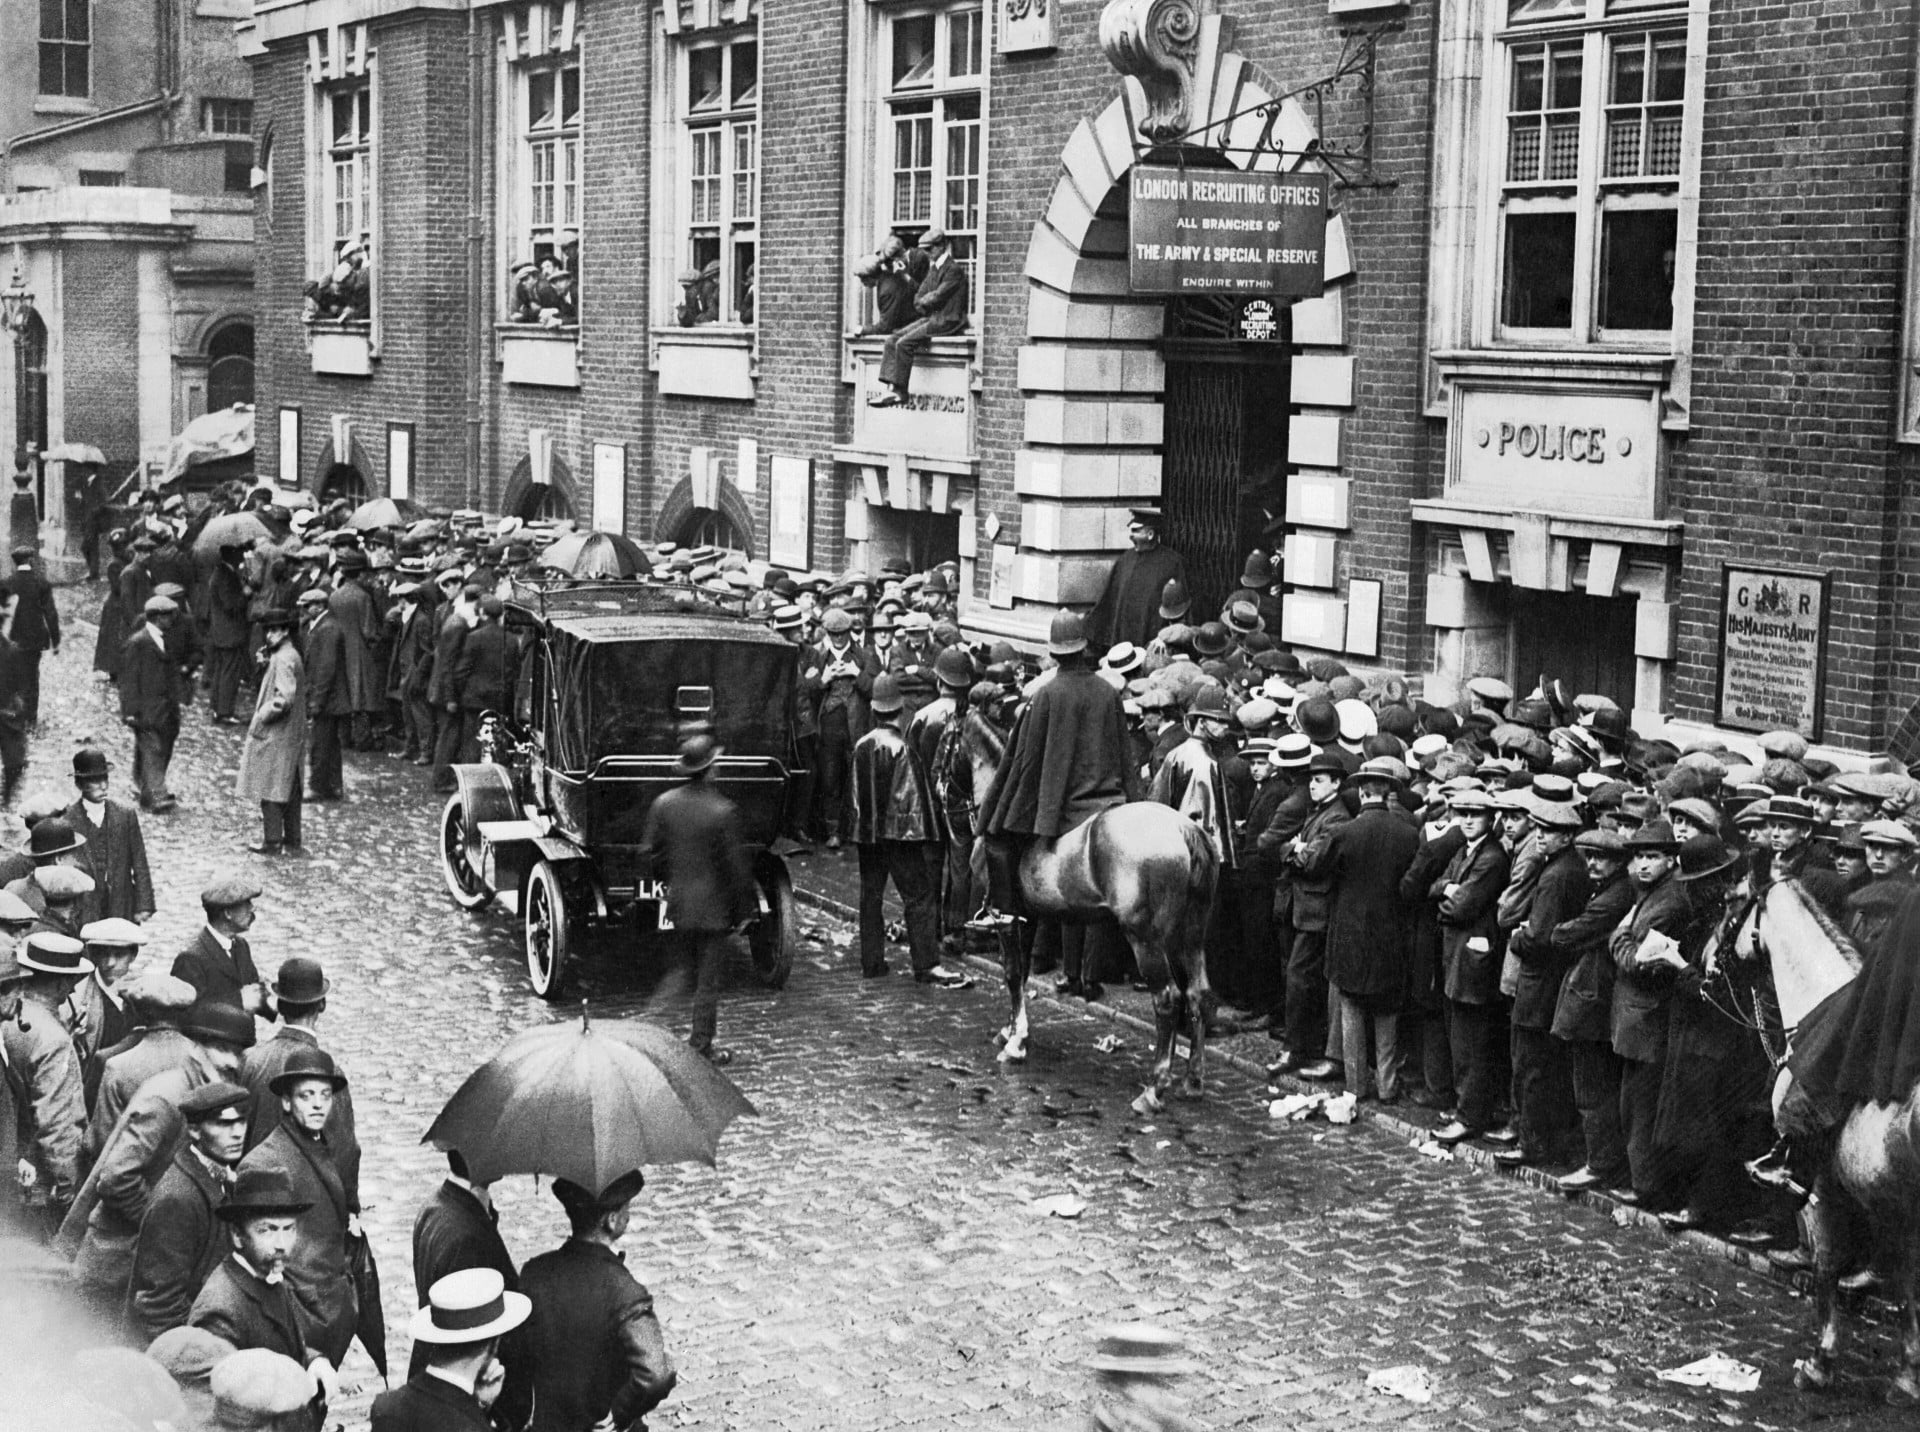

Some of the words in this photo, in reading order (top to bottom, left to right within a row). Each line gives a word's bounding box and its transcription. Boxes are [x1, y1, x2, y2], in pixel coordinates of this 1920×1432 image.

[1135, 178, 1188, 201] LONDON
[1192, 181, 1266, 204] RECRUITING
[1270, 185, 1320, 206] OFFICES
[1176, 218, 1198, 229] ALL
[1202, 218, 1263, 231] BRANCHES
[1267, 220, 1282, 231] OF
[1135, 244, 1161, 260] THE
[1164, 245, 1201, 262] ARMY
[1203, 248, 1211, 262] &
[1213, 248, 1263, 263] SPECIAL
[1266, 249, 1319, 265] RESERVE
[1182, 277, 1232, 288] ENQUIRE
[1236, 279, 1274, 289] WITHIN
[1243, 299, 1274, 316] CENTRAL
[1241, 320, 1277, 330] RECRUITING
[1246, 329, 1271, 340] DEPOT
[1499, 422, 1606, 464] POLICE
[1737, 586, 1749, 607] G
[1799, 593, 1811, 615] R
